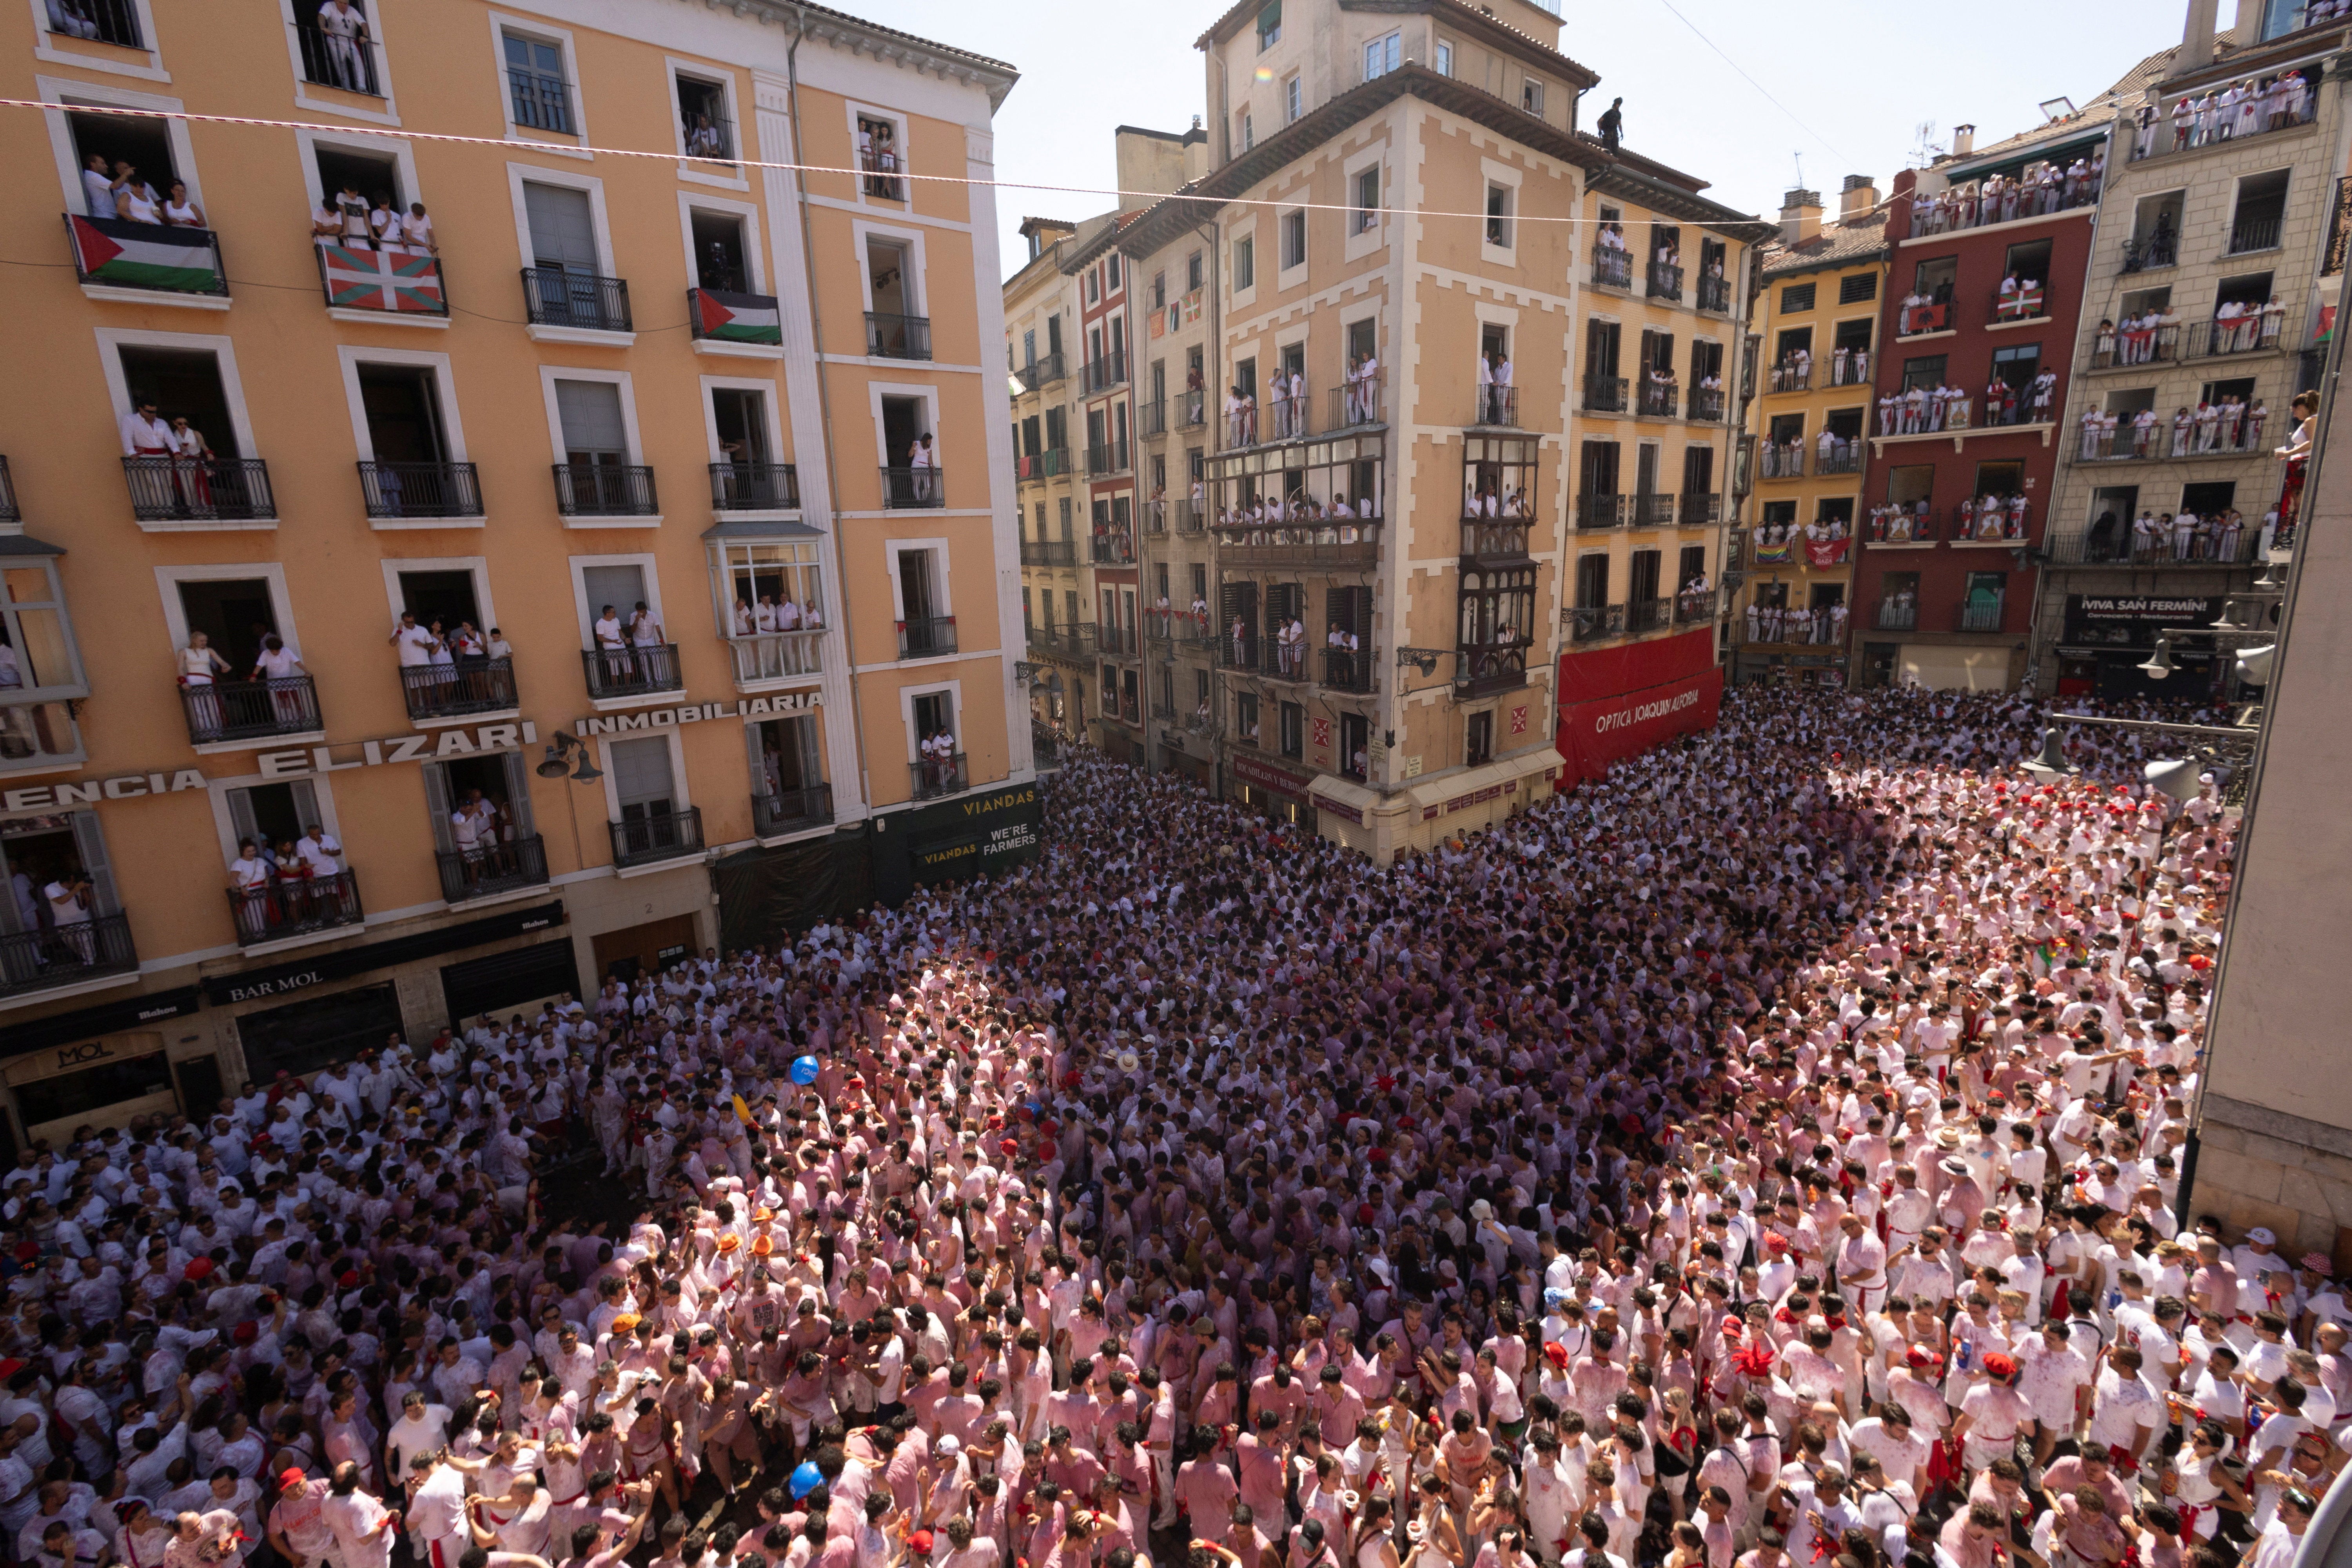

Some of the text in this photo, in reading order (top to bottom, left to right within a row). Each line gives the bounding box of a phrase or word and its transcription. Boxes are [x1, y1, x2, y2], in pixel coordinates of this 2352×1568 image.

[2117, 601, 2147, 610] SAN
[2150, 598, 2207, 611] FERMÍN!
[1596, 710, 1631, 733] OPTICA
[1634, 699, 1671, 724] JOAQUIN
[0, 691, 827, 812] ENCIA ELIZARI INMOBILIARIA
[1237, 761, 1308, 796] BOCADILLOS Y BEBIDAS
[963, 789, 1034, 816] VIANDAS
[1424, 806, 1437, 815] HIELOS
[925, 844, 976, 864] VIANDAS
[984, 834, 1036, 856] FARMERS
[645, 903, 653, 915] 2
[522, 919, 549, 929] Mahou
[230, 971, 323, 1002] BAR MOL
[138, 1006, 177, 1020] Mahou
[58, 1041, 114, 1069] MOL
[801, 1067, 817, 1078] DIGI
[754, 1310, 774, 1320] ASCO
